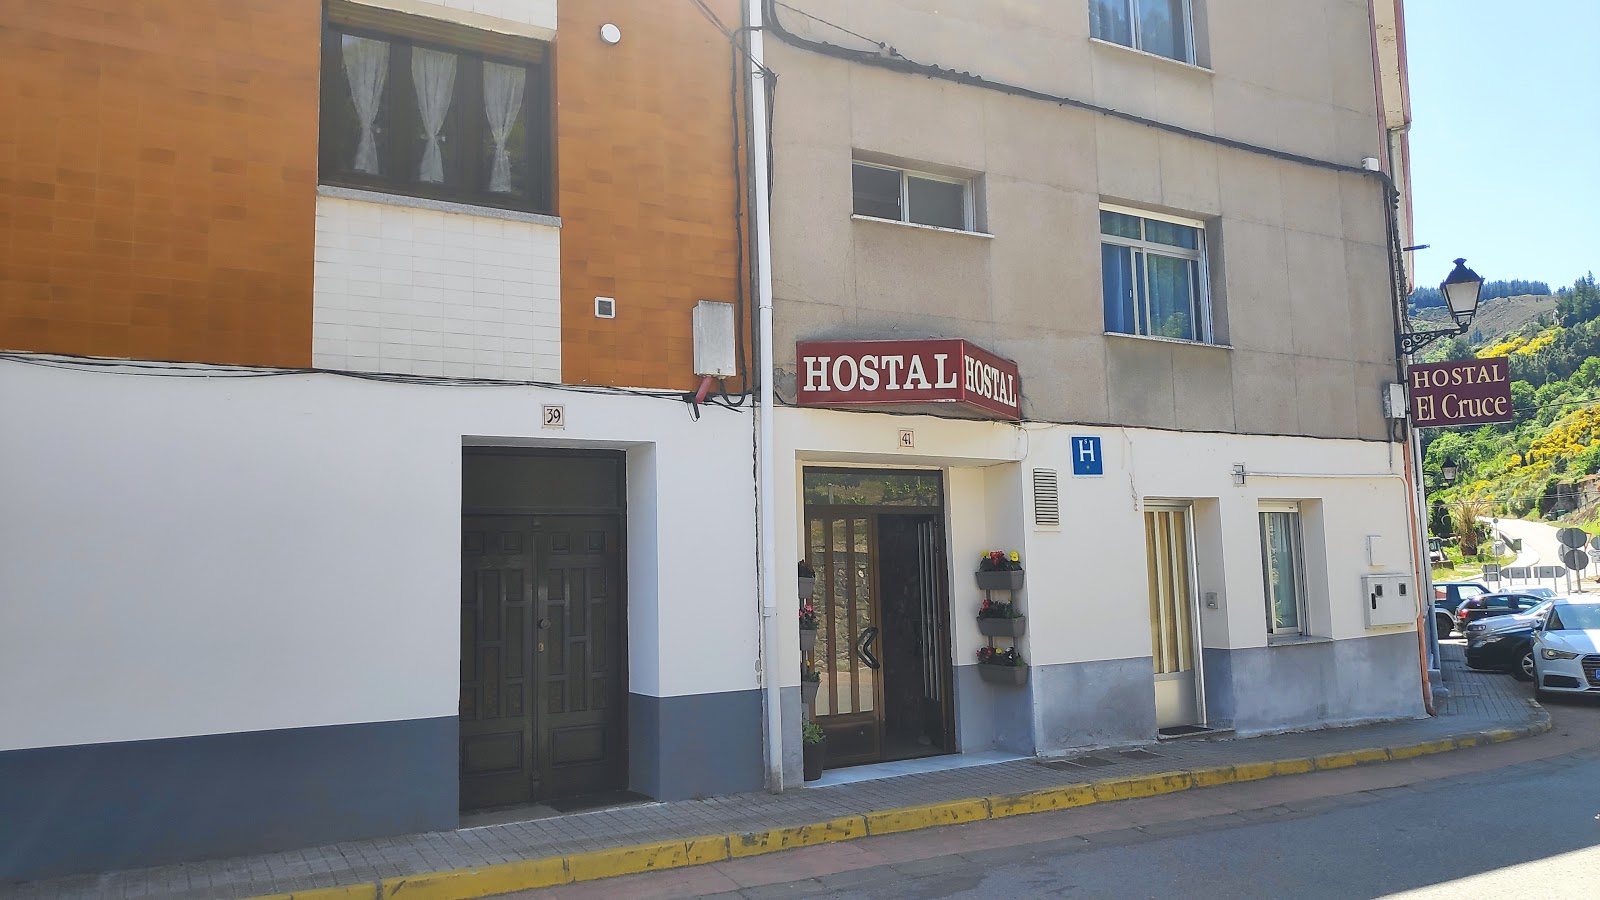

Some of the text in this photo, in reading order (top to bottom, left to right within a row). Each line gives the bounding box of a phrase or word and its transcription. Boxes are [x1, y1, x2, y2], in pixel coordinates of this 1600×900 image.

[803, 354, 957, 392] HOSTAL
[964, 354, 1017, 408] HOSTAL
[1413, 365, 1505, 388] HOSTAL
[546, 409, 561, 423] 39
[1415, 393, 1507, 421] El Cruce
[902, 432, 911, 445] 41
[1078, 439, 1095, 462] H
